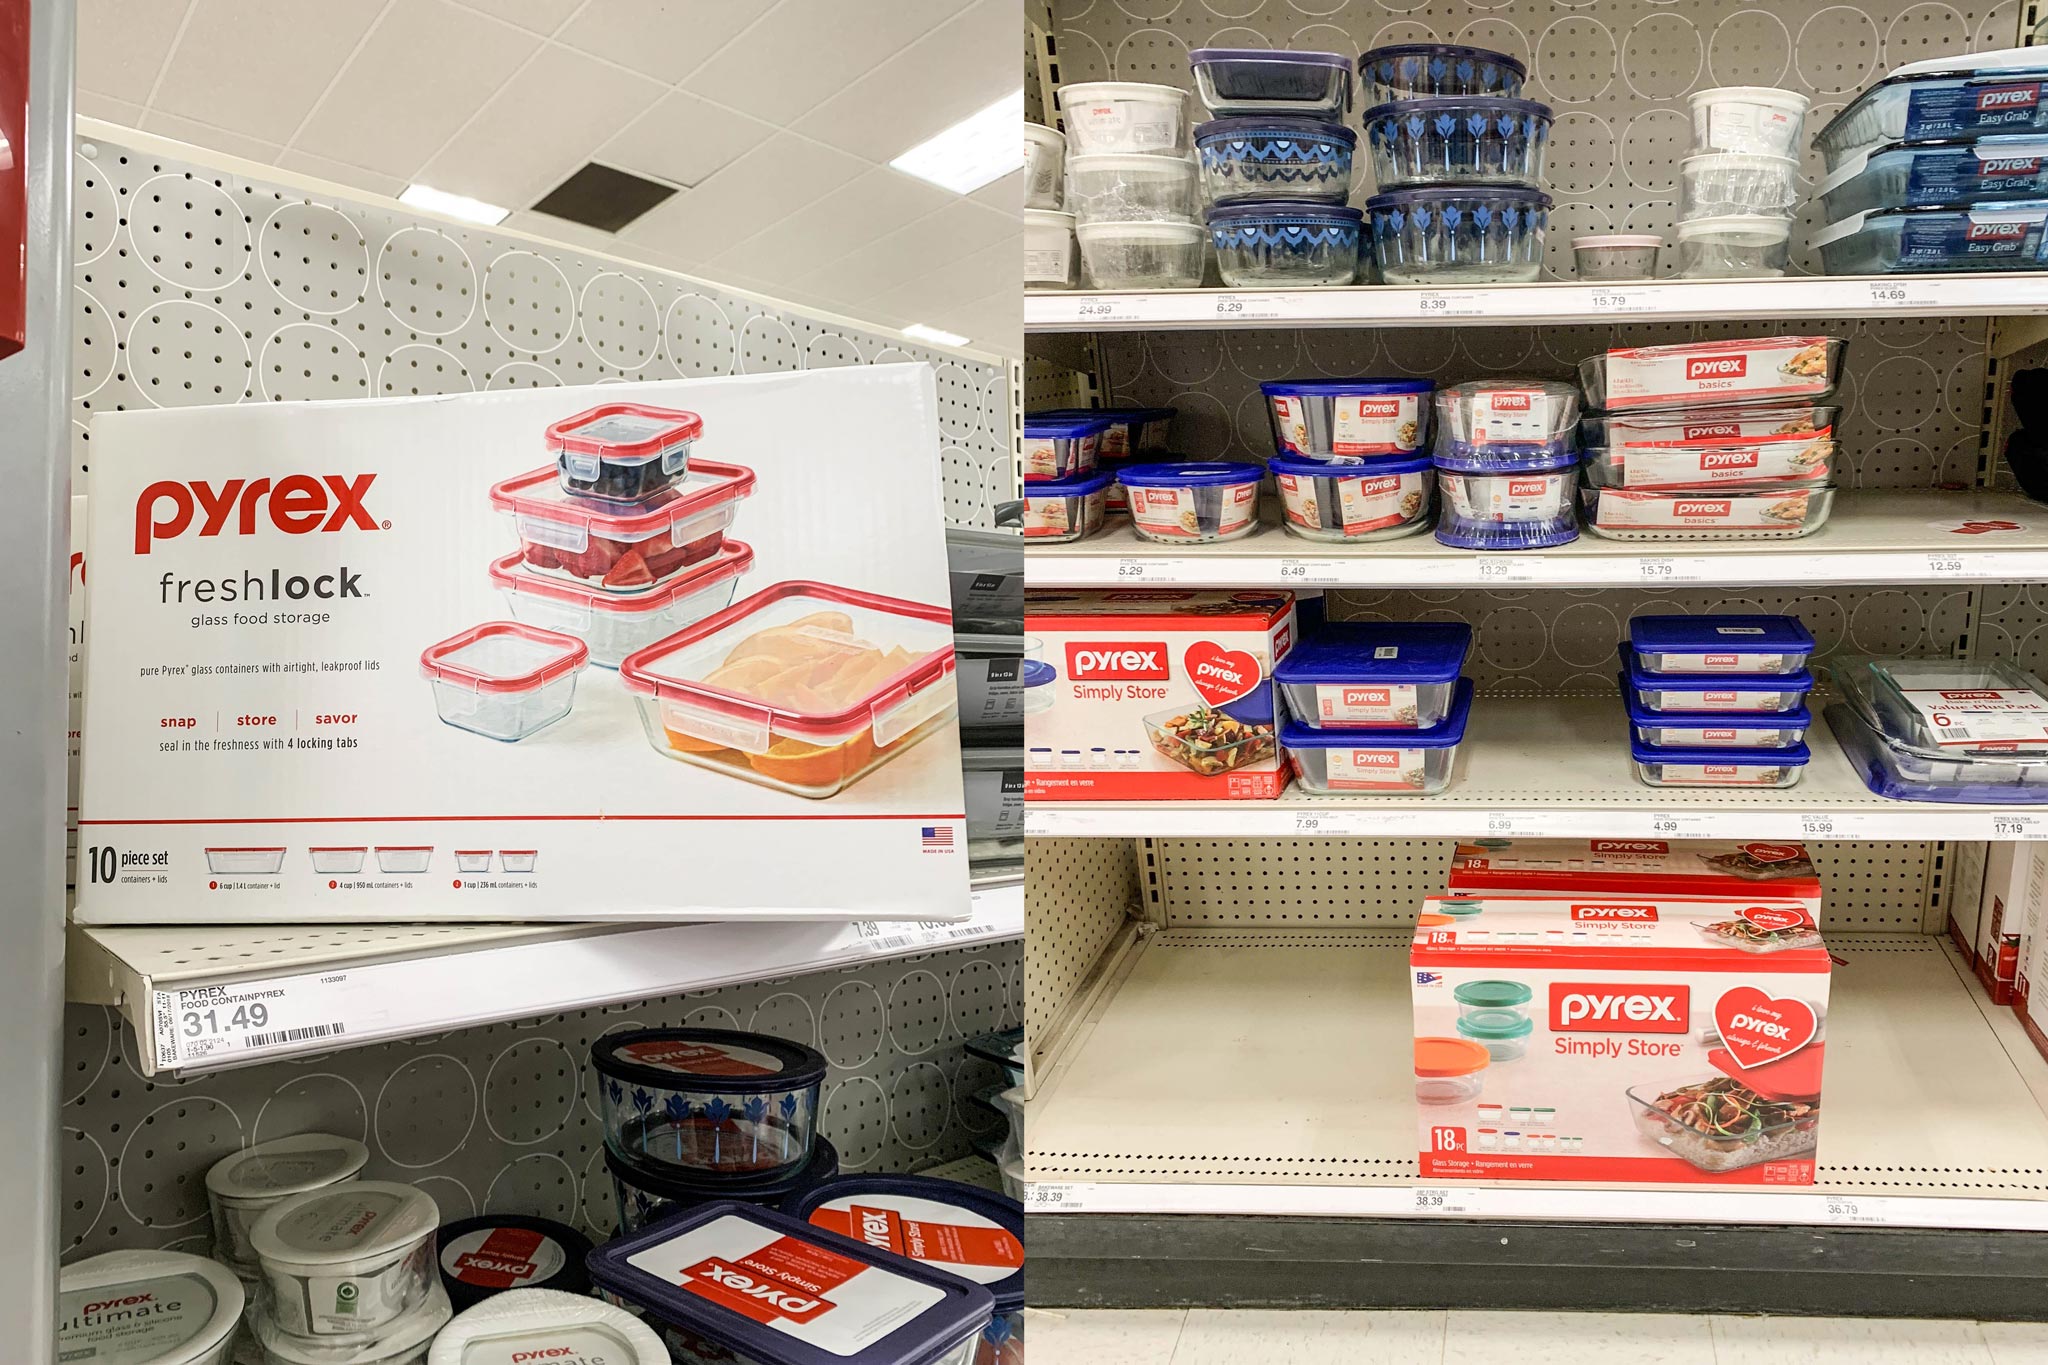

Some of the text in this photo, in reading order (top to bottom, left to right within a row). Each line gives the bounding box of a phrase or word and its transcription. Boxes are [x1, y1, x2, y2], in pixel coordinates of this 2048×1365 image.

[1979, 110, 2029, 125] Easy Grab
[1980, 177, 2030, 191] Easy Grab
[1968, 242, 2017, 254] Easy Grab
[1871, 290, 1906, 300] 14.69
[1420, 300, 1447, 309] 8.39
[1592, 296, 1626, 306] 15.79
[1079, 305, 1112, 315] 24.99
[1217, 303, 1243, 312] 6.29
[1699, 381, 1733, 390] basics
[1711, 469, 1744, 478] basics
[1118, 567, 1143, 575] 5.29
[1281, 567, 1306, 576] 6.49
[1479, 566, 1507, 575] 13.29
[1640, 565, 1672, 575] 15.79
[1929, 562, 1962, 571] 12.59
[159, 566, 362, 604] freshlock
[191, 610, 330, 628] glass food storage
[1075, 650, 1160, 676] pyrex
[140, 667, 160, 679] pure
[191, 663, 214, 677] glass
[215, 663, 260, 676] containers
[262, 663, 282, 674] with
[283, 660, 319, 676] airtight,
[321, 660, 362, 674] leakproof
[364, 659, 380, 671] lids
[1073, 685, 1166, 701] Simply Store
[160, 716, 197, 731] snap
[237, 713, 277, 727] store
[315, 712, 358, 726] savor
[1933, 713, 1951, 727] 6
[159, 735, 358, 753] seal in the freshness with 4 locking tabs
[1296, 819, 1318, 828] 7.99
[1488, 820, 1512, 829] 6.99
[1654, 821, 1677, 831] 4.99
[1802, 823, 1832, 833] 15.99
[1995, 824, 2023, 833] 17.19
[121, 850, 169, 867] piece set
[88, 846, 117, 884] 10
[1467, 859, 1482, 869] 18
[121, 875, 168, 884] containers lids
[1575, 921, 1617, 930] Simply
[1431, 932, 1448, 944] 18
[320, 975, 347, 985] 1133097
[179, 986, 227, 1002] PYREX
[181, 989, 286, 1010] FOOD CONTAINPYREX
[1561, 993, 1677, 1026] pyrex
[183, 1003, 269, 1038] 31.49
[1555, 1037, 1681, 1058] Simply Store
[1434, 1129, 1464, 1151] 18 PC
[1432, 1159, 1447, 1167] Glass
[1448, 1160, 1470, 1169] Storage
[1475, 1160, 1508, 1169] Rangement
[1036, 1192, 1062, 1202] 38.39
[1416, 1196, 1443, 1206] 38.39
[1828, 1204, 1858, 1215] 36.79
